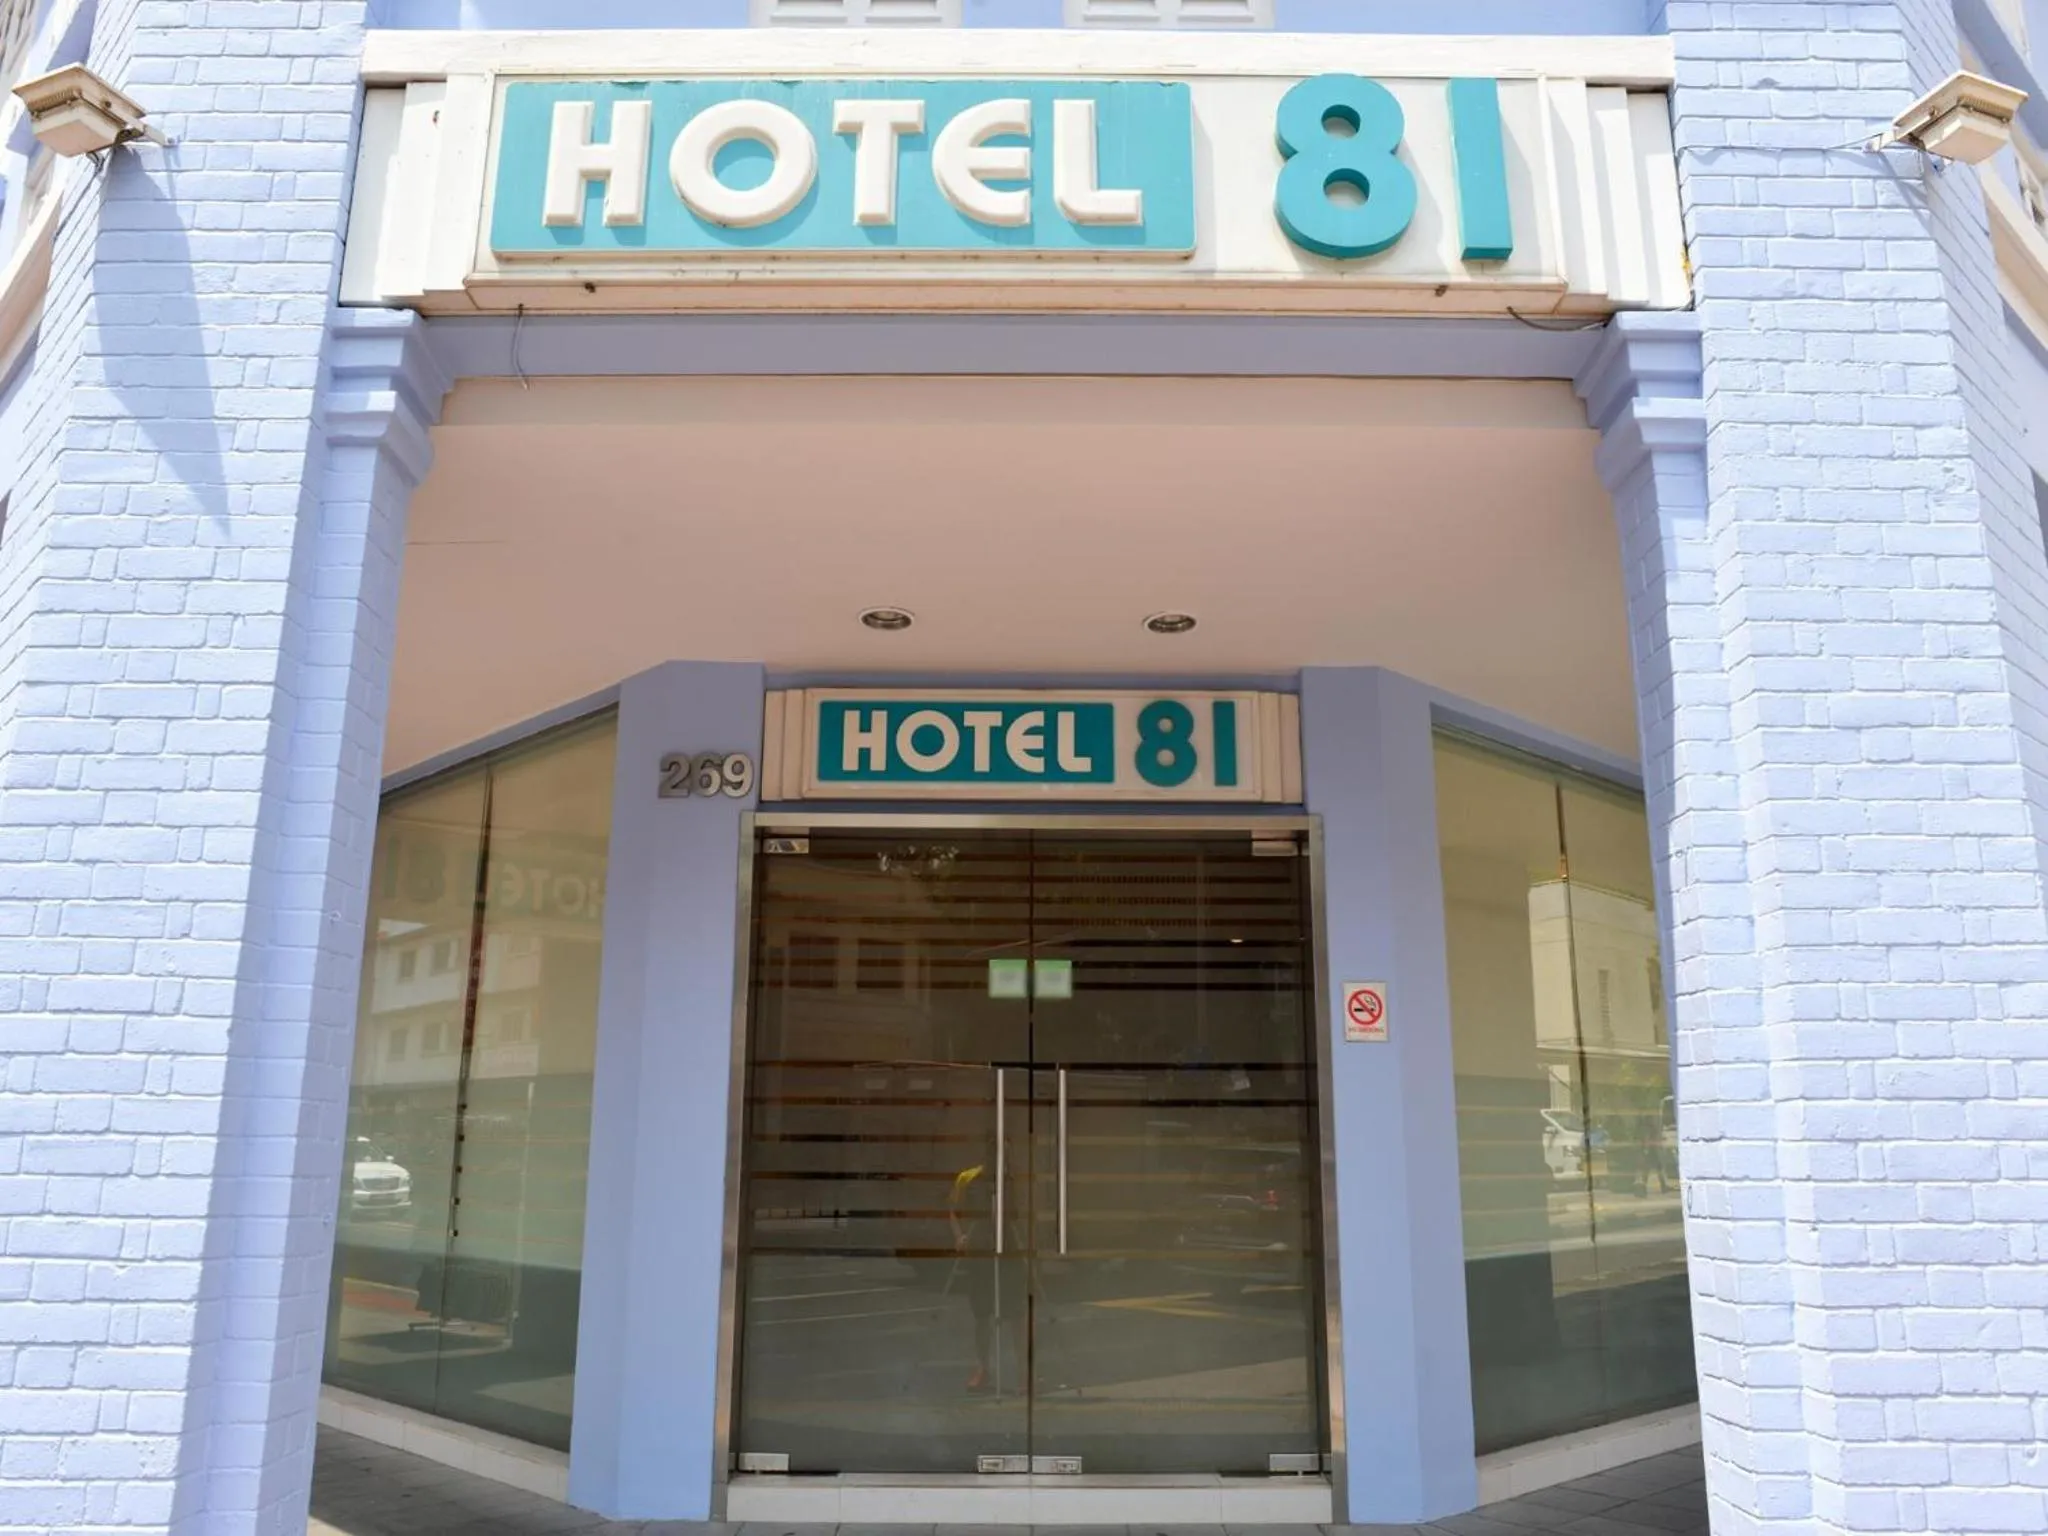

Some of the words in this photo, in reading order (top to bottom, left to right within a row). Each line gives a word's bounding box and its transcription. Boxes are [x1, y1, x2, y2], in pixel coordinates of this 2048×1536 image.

[542, 98, 1144, 227] HOTEL
[1274, 73, 1512, 260] 81
[659, 752, 754, 798] 269
[841, 710, 1091, 772] HOTEL
[1134, 700, 1237, 787] 81
